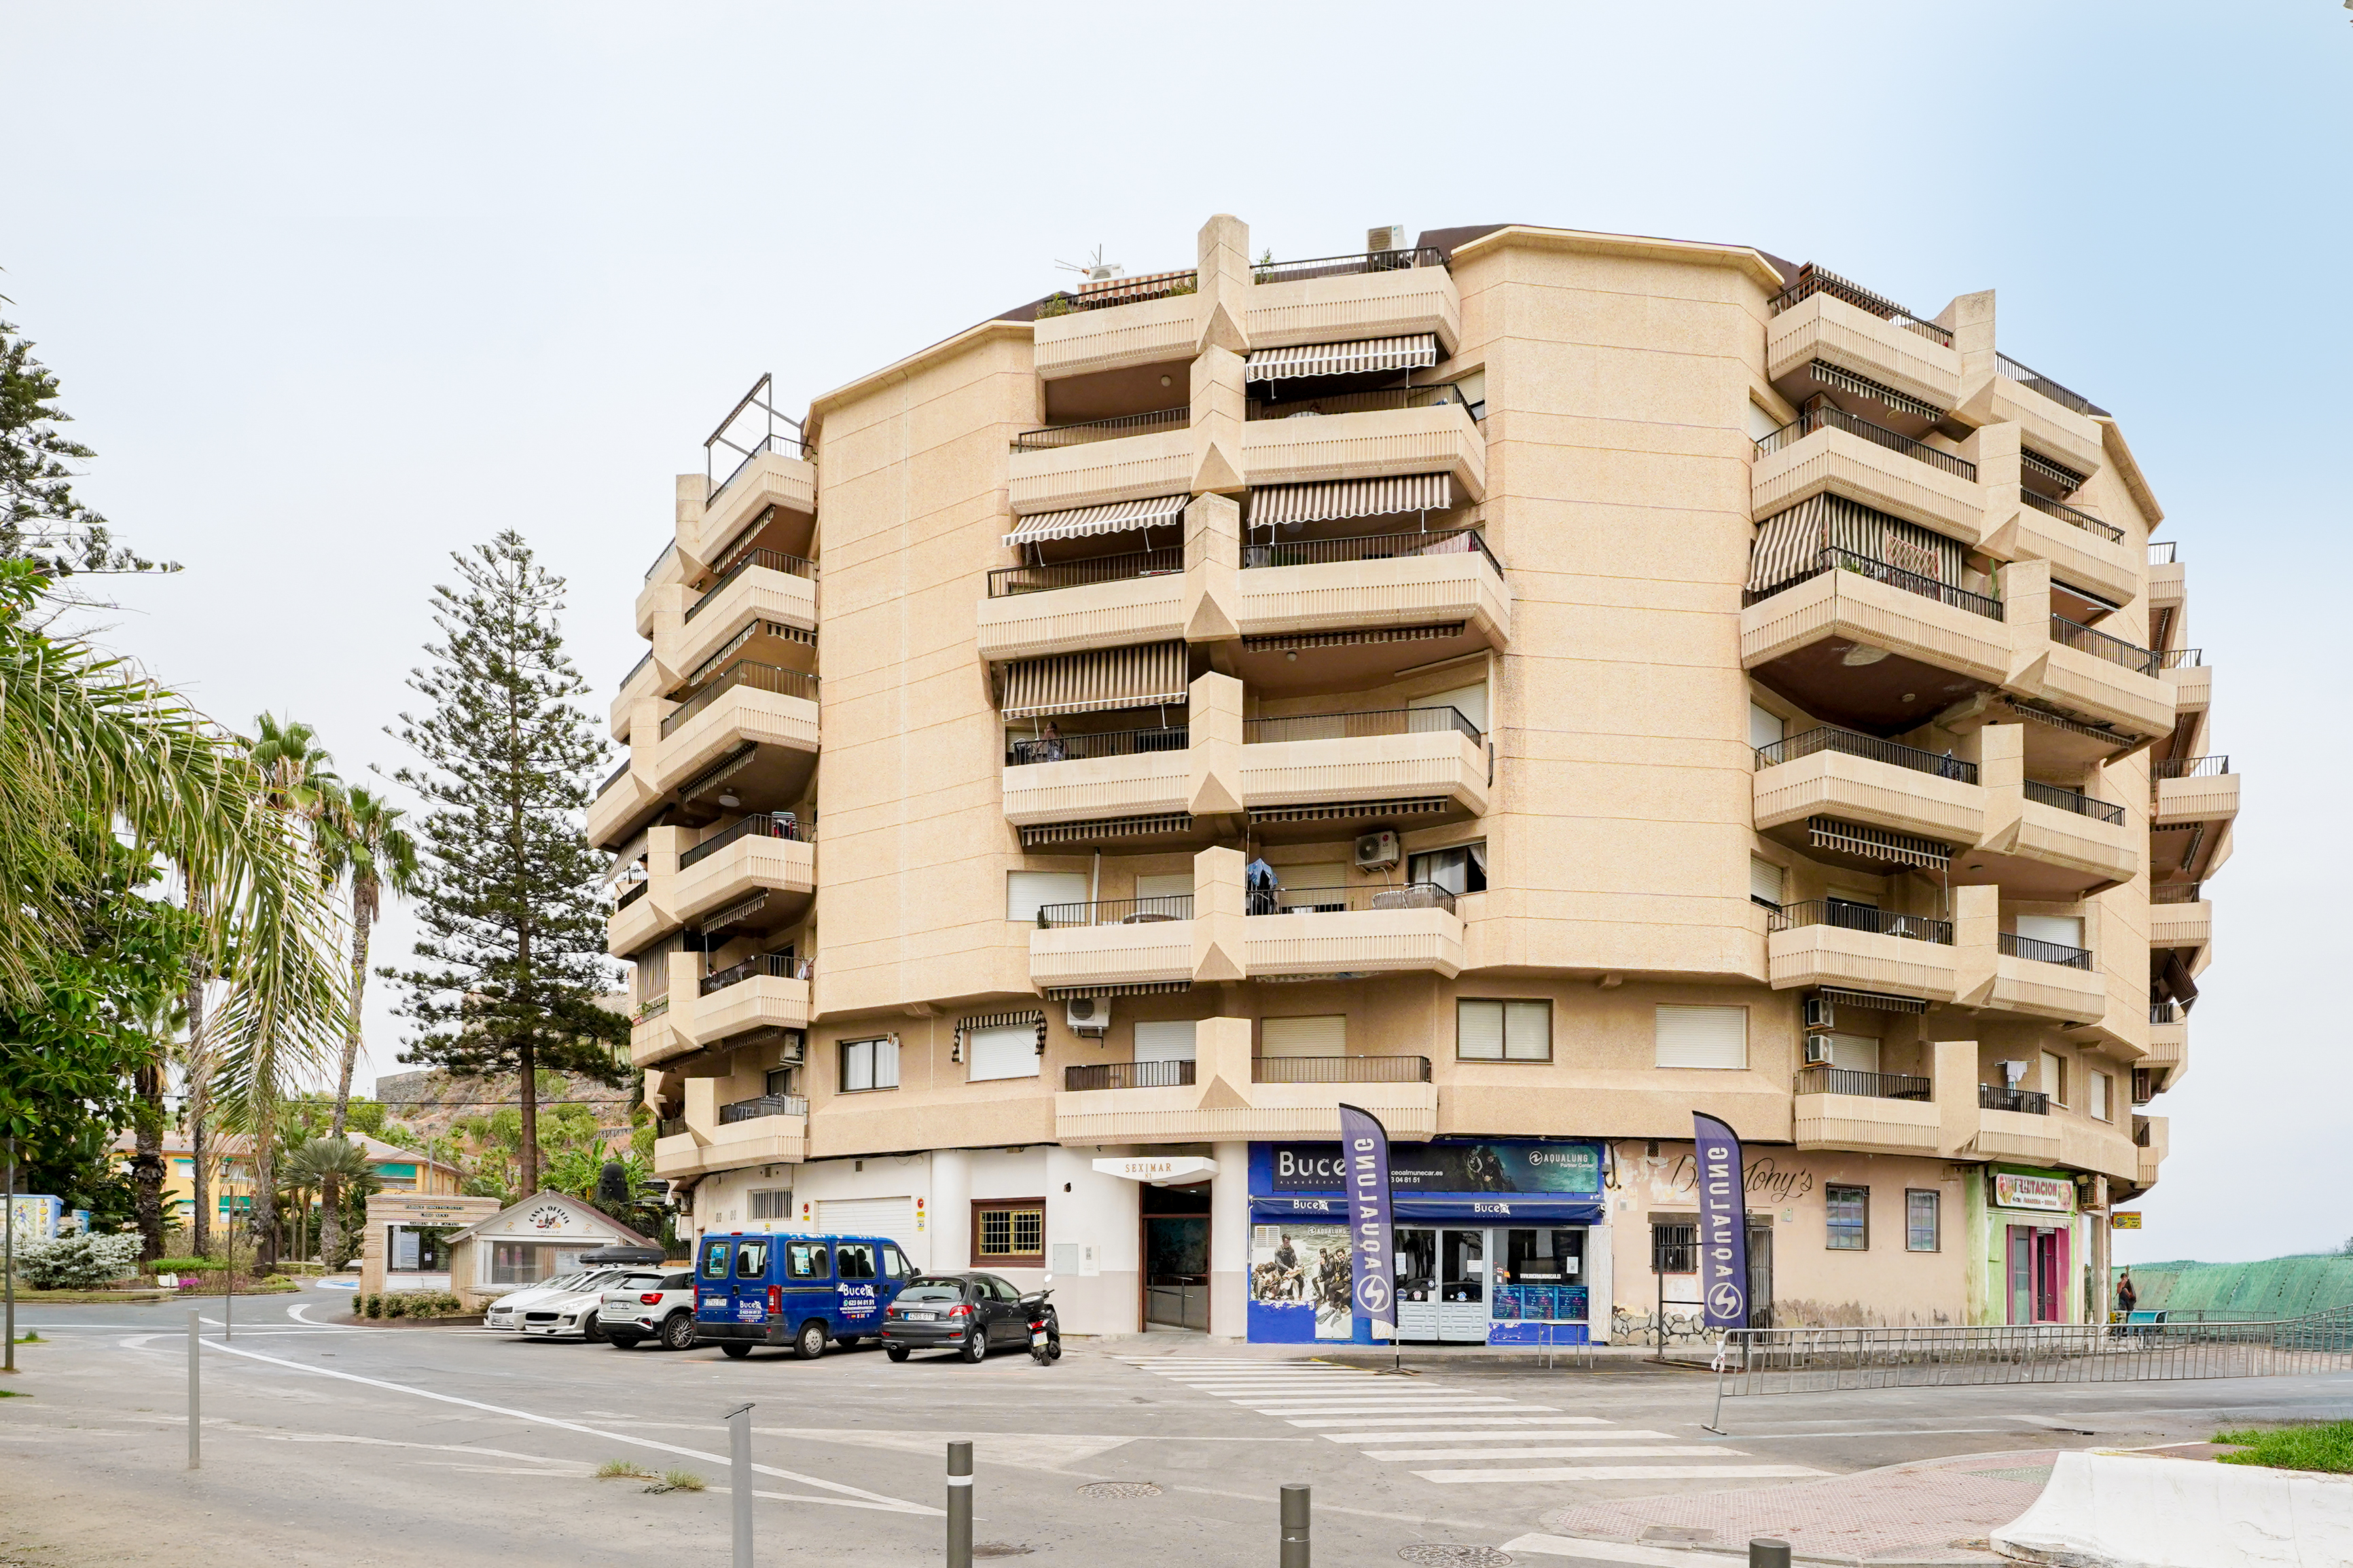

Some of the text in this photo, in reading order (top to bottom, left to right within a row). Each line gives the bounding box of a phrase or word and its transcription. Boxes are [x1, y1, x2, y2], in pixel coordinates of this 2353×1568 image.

[1126, 1163, 1171, 1172] SEXIMAR
[1280, 1151, 1347, 1177] Buce
[1543, 1154, 1588, 1164] AQUALUNG
[1744, 1157, 1812, 1203] Tony's
[528, 1205, 570, 1224] CASA OFELIA
